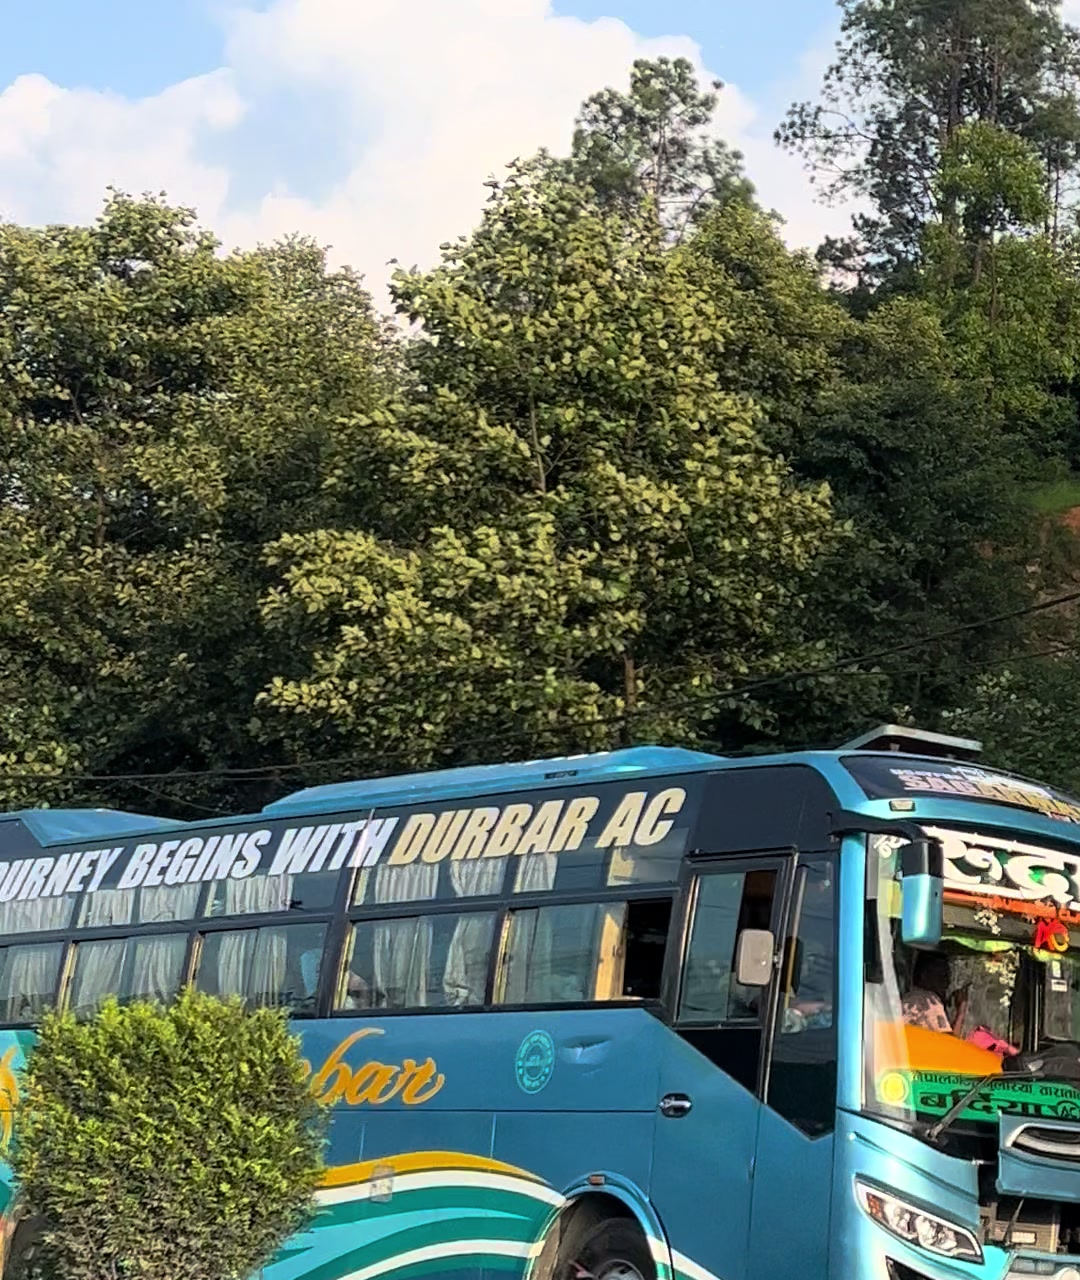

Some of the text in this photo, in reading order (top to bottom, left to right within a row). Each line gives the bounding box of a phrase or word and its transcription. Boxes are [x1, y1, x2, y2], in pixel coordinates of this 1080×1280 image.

[117, 829, 272, 889] BEGINS
[268, 817, 399, 876] WITH
[387, 796, 600, 866] DURBAR
[594, 787, 687, 848] AC
[299, 1027, 445, 1105] bar
